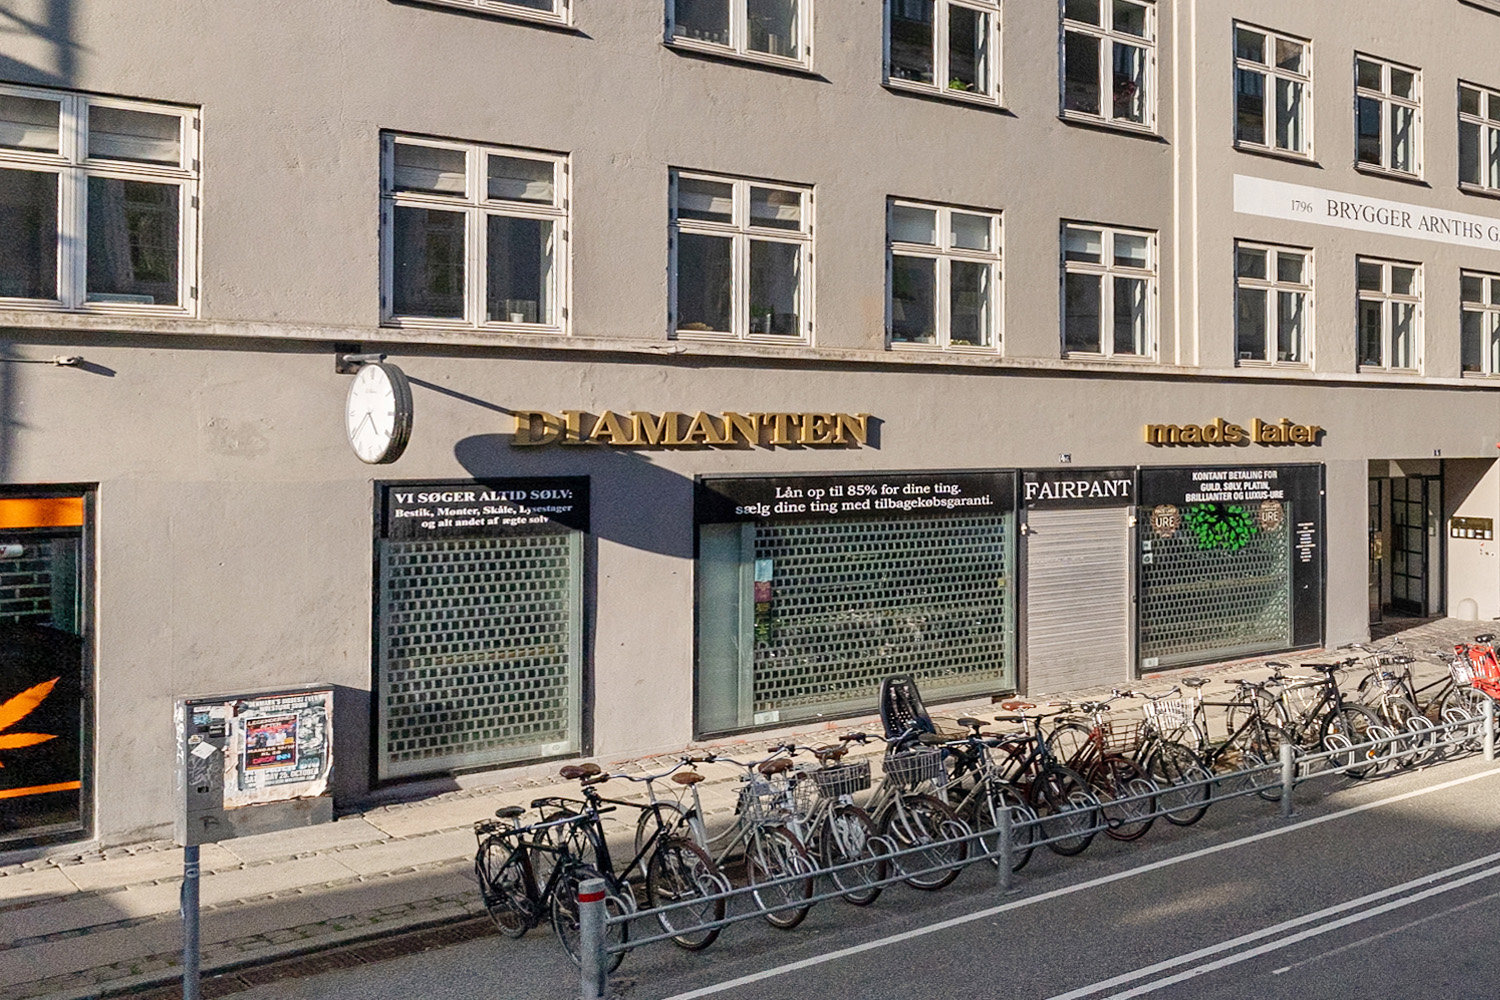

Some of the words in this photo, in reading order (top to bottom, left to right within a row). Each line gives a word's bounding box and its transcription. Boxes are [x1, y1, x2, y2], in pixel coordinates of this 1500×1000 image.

[1291, 199, 1313, 213] 1796
[1326, 199, 1412, 229] BRYGGER
[1418, 215, 1483, 240] ARNTHS
[509, 409, 873, 446] DIAMANTEN
[1144, 417, 1243, 445] mads
[1252, 417, 1321, 445] laier
[1192, 471, 1227, 481] KONTANT
[1228, 471, 1263, 480] BETALING
[1263, 470, 1278, 479] FOR
[394, 493, 414, 503] VI
[417, 491, 476, 503] SØGER
[479, 490, 527, 501] ALTID
[530, 489, 573, 500] SØLV:
[775, 486, 803, 499] Lån
[807, 488, 825, 500] op
[828, 485, 844, 497] til
[847, 484, 878, 497] 85%
[880, 483, 900, 495] for
[902, 482, 931, 494] dine
[934, 482, 962, 495] ting.
[1024, 479, 1132, 500] FAIRPANT
[1185, 491, 1233, 502] BRILLIANTER
[1233, 491, 1244, 500] OG
[1244, 489, 1284, 500] LUXUS-URE
[394, 508, 435, 518] Bestik,
[519, 505, 573, 515] Lysestager
[735, 503, 771, 517] sælg
[774, 500, 807, 513] dine
[810, 500, 838, 513] ting
[841, 498, 871, 511] med
[421, 520, 436, 529] og
[438, 518, 453, 527] alt
[455, 517, 485, 526] andet
[487, 516, 500, 525] af
[1155, 516, 1175, 528] URE
[1261, 511, 1280, 521] URE
[252, 755, 276, 765] DROP
[276, 752, 291, 761] INN
